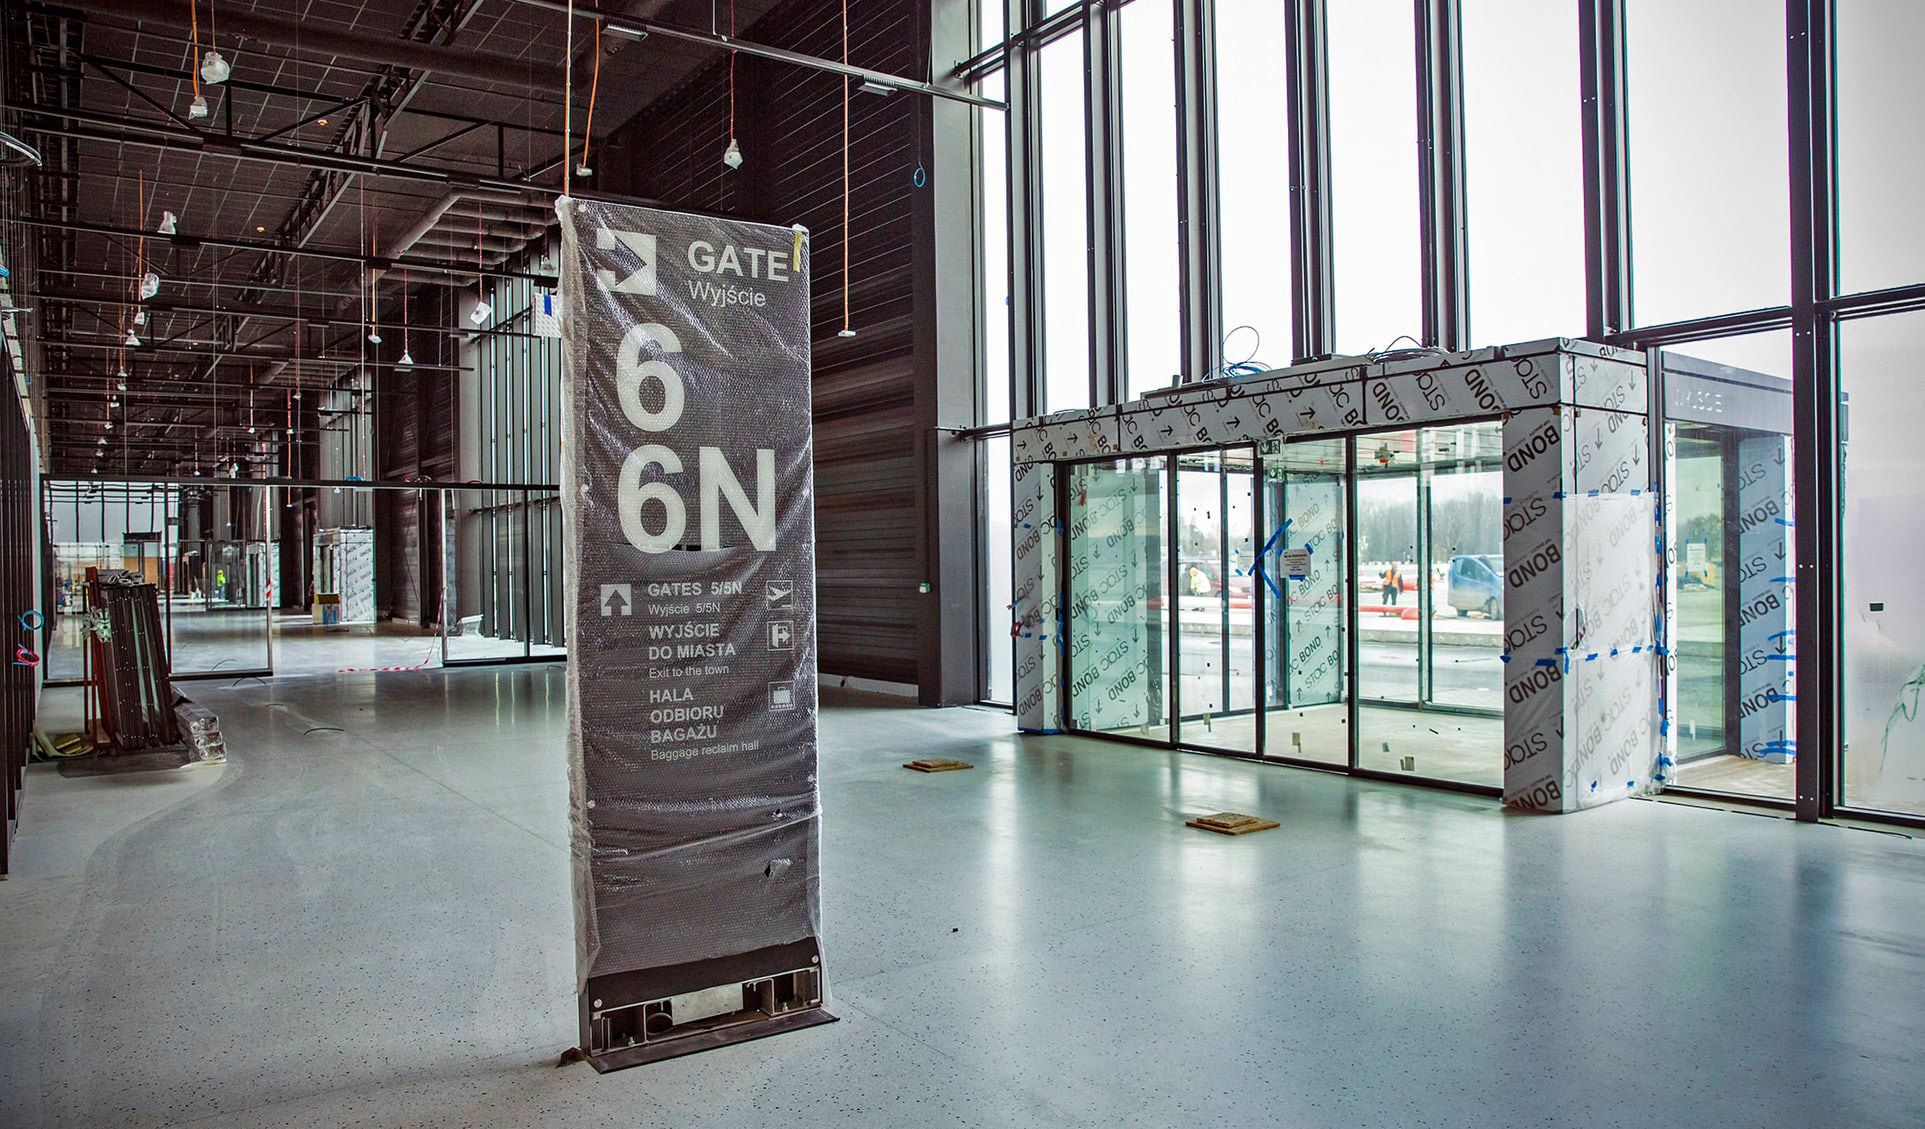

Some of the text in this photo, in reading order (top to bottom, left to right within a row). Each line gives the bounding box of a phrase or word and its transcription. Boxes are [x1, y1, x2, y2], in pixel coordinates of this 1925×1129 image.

[687, 241, 790, 283] GATE
[688, 278, 766, 308] Wyjście
[616, 323, 685, 432] 6
[1465, 369, 1502, 412] OND
[1372, 382, 1405, 422] OND
[1507, 425, 1560, 472] BOND
[617, 445, 776, 554] 6N
[1508, 544, 1561, 588] BOND
[648, 581, 742, 597] GATES 5/5N
[648, 603, 720, 617] Wyjście 5/5N
[649, 621, 720, 639] WYJŚCIE
[649, 643, 736, 660] DO MIASTA
[1299, 636, 1322, 663] BOND
[650, 665, 730, 679] Exit to the town
[1108, 670, 1136, 700] BOND
[1508, 666, 1562, 704] BOND
[649, 688, 693, 703] HALA
[649, 705, 724, 724] ODBIORU
[650, 725, 718, 744] BAGAŻU
[651, 740, 759, 761] Baggage reclaim hall
